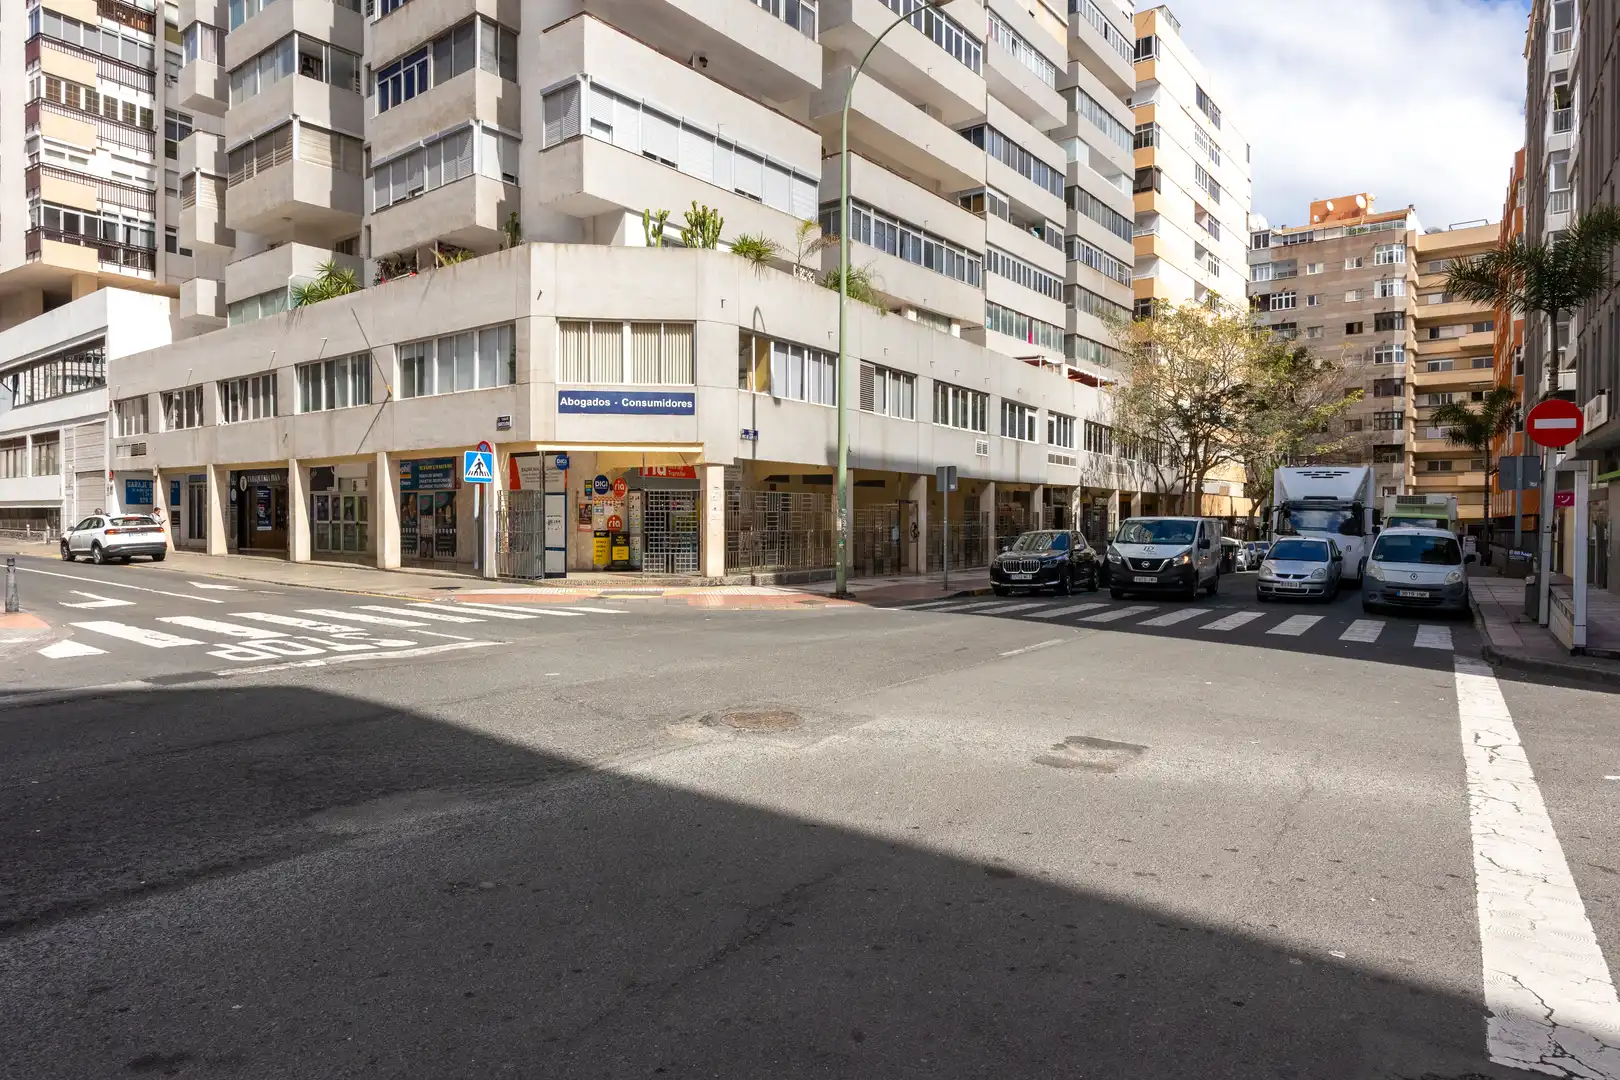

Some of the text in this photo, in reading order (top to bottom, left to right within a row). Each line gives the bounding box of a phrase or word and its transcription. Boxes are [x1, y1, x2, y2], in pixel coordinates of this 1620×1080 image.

[560, 397, 611, 408] Abogados
[621, 398, 693, 408] Consumidores
[614, 480, 625, 491] ria
[608, 516, 621, 528] ria
[205, 631, 418, 661] STOP
